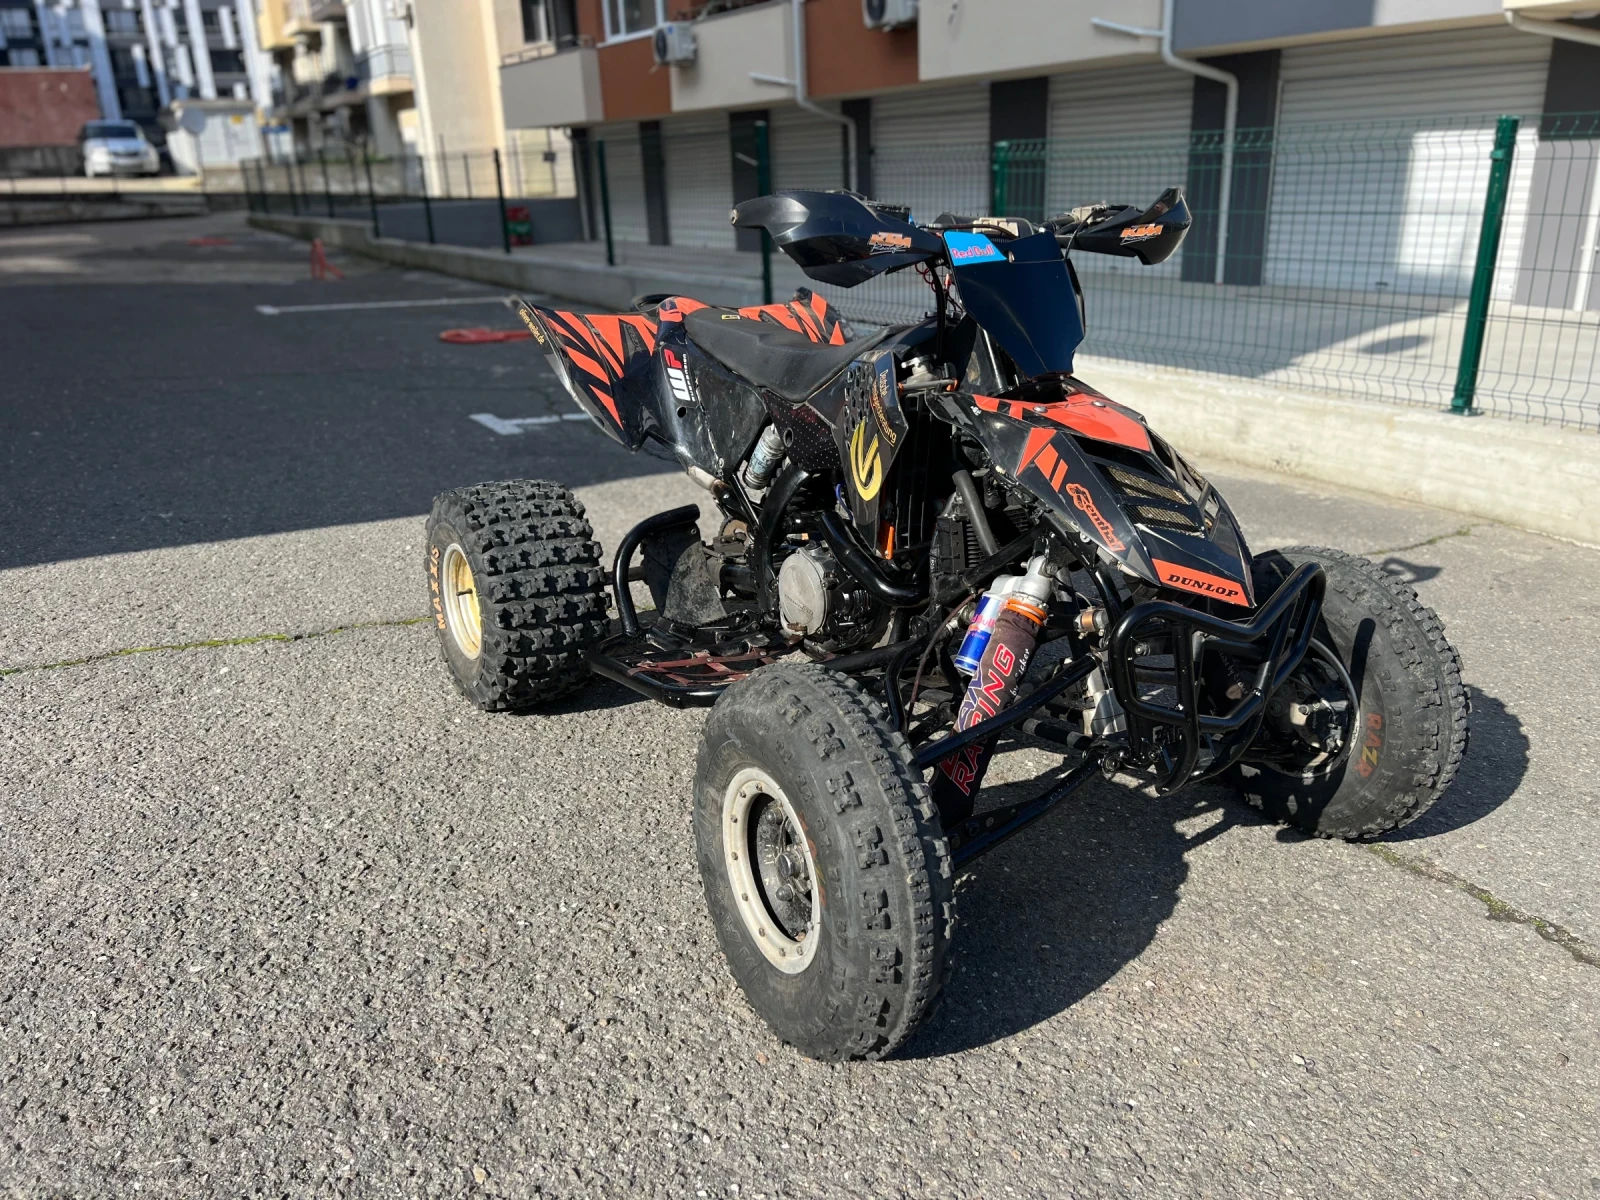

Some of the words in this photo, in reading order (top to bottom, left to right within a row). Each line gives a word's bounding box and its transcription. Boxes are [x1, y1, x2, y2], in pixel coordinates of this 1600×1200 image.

[868, 232, 912, 248] KTM
[1120, 224, 1163, 237] KTM
[952, 248, 974, 258] Red
[975, 245, 994, 256] Bull
[663, 348, 691, 401] WP
[430, 544, 447, 629] MAXXIS
[1167, 574, 1238, 597] DUNLOP
[1353, 712, 1383, 778] RAZR
